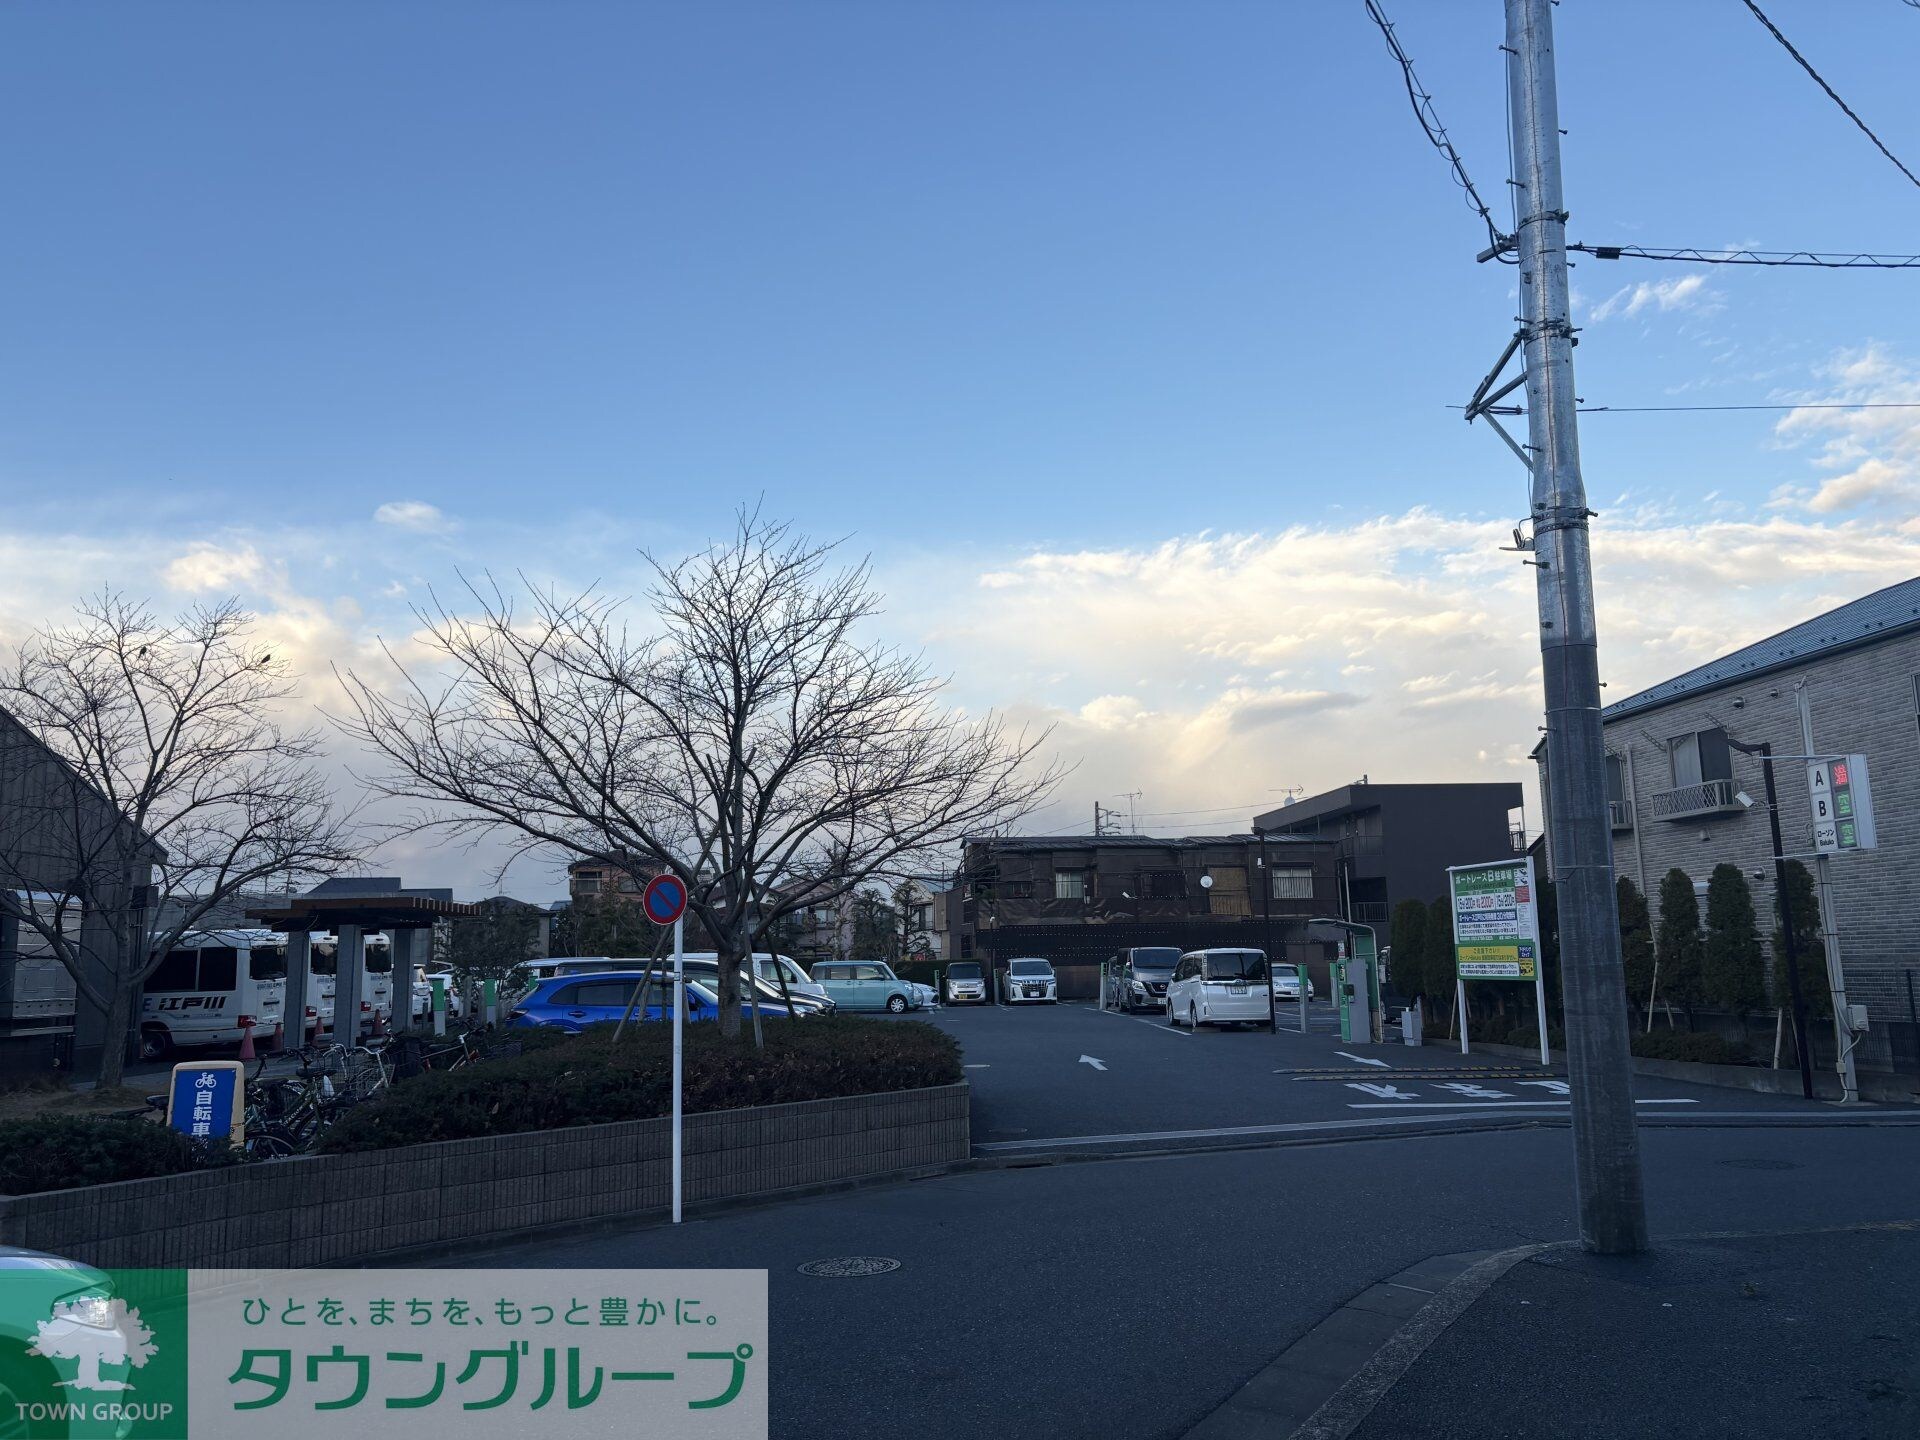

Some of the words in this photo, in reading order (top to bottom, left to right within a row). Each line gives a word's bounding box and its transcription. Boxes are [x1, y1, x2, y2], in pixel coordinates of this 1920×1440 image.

[1816, 771, 1824, 786] A
[1819, 801, 1826, 816] B
[1818, 829, 1834, 837] ローソン
[192, 1090, 213, 1137] 自転車
